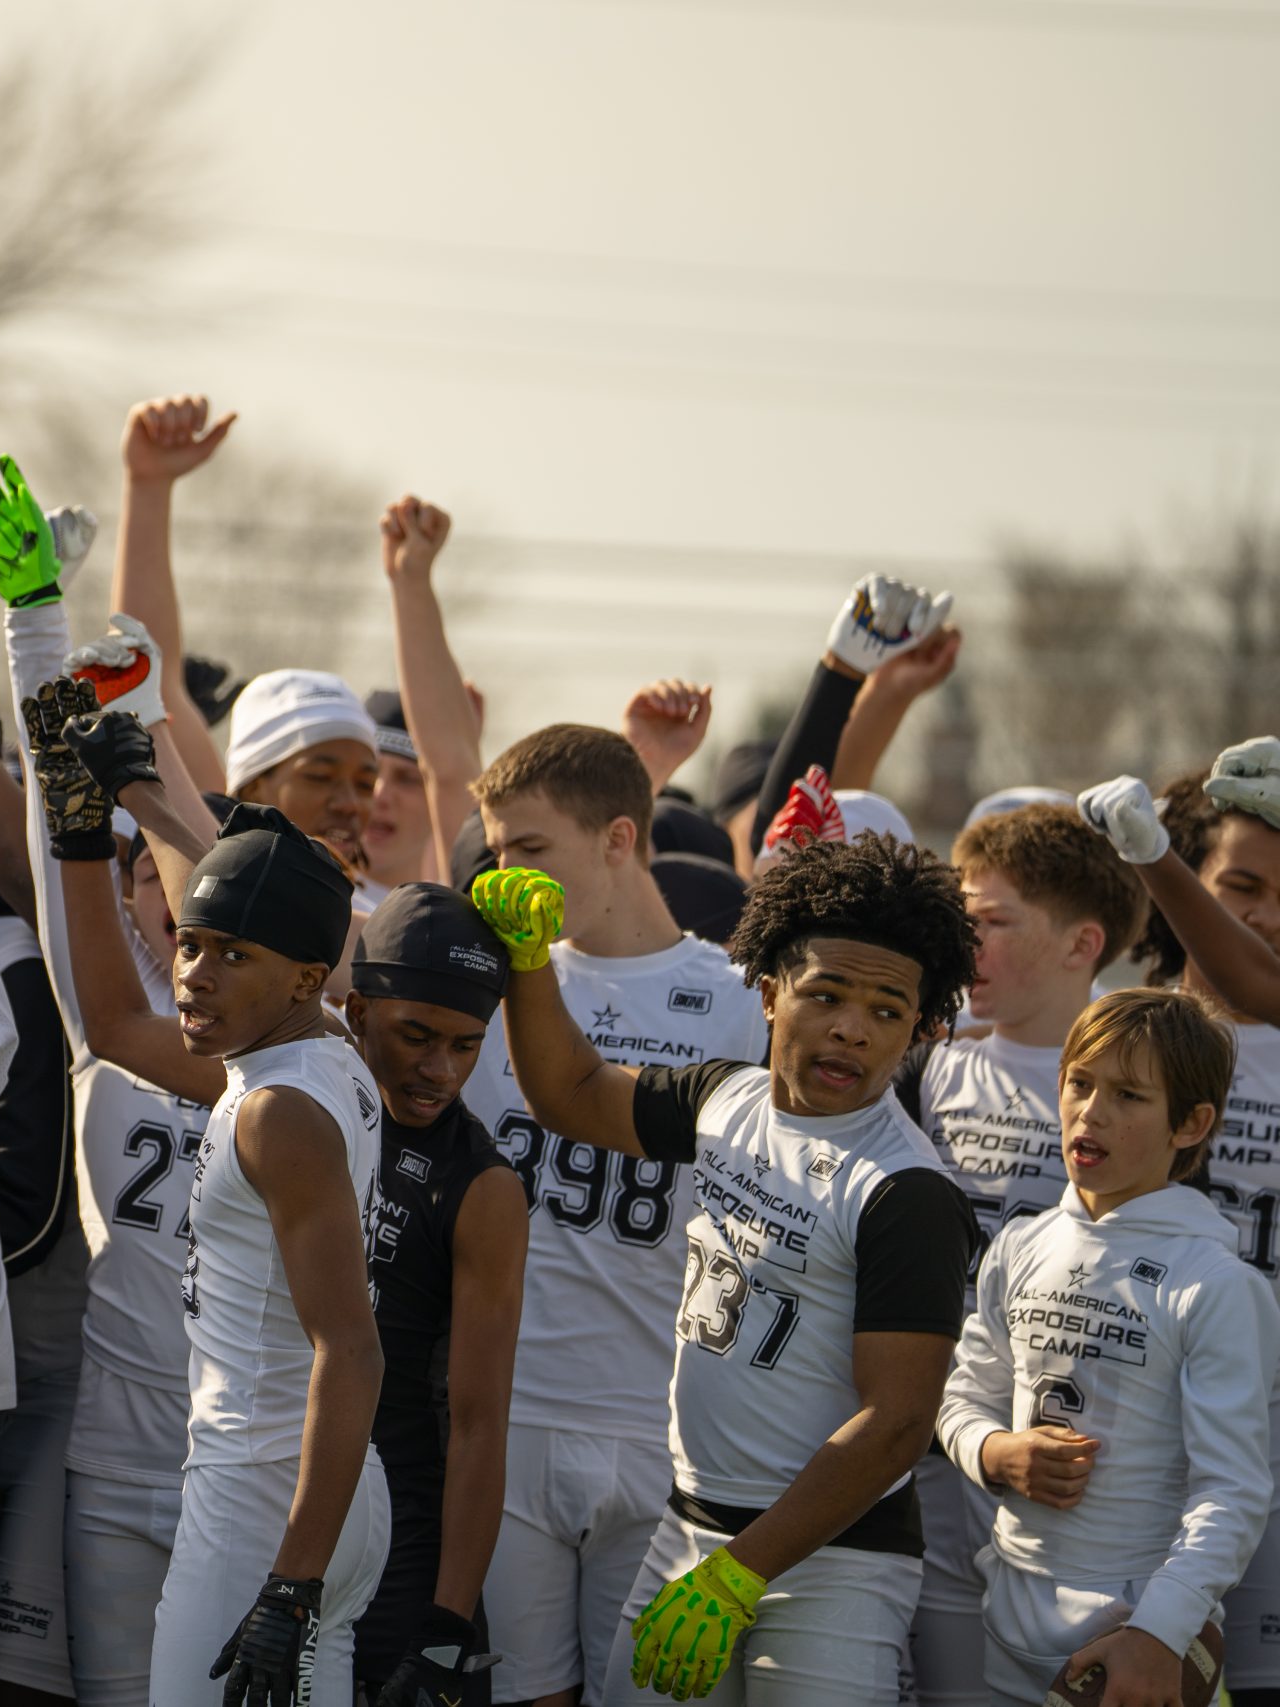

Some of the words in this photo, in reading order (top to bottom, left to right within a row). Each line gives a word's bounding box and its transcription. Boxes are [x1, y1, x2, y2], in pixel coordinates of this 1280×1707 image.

[449, 951, 498, 970] EXPOSURE
[464, 961, 488, 971] CAMP
[586, 1033, 695, 1059] MERICAN
[960, 1156, 1041, 1179] CAMP
[1015, 1289, 1144, 1323] ALL-AMERICAN
[1008, 1308, 1147, 1350] EXPOSURE
[1029, 1334, 1102, 1360] CAMP
